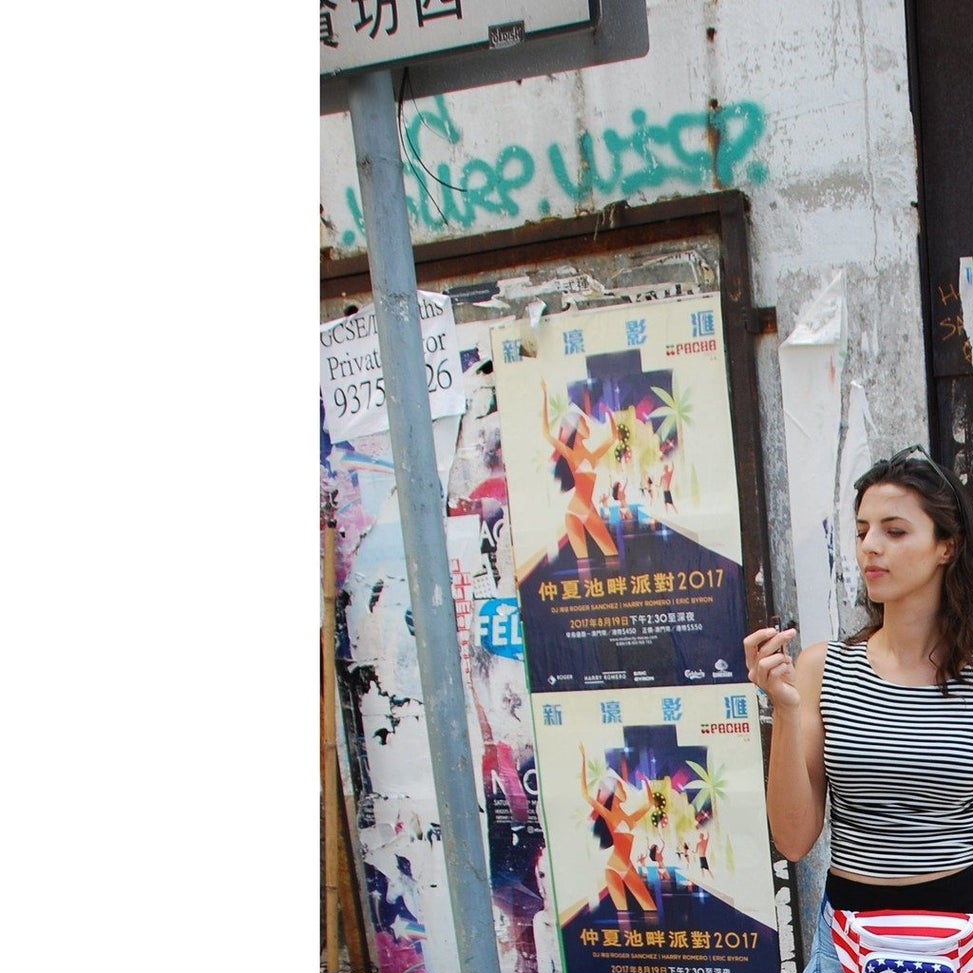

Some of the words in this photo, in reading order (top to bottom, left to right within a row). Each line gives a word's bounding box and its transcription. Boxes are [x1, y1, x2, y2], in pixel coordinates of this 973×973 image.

[675, 339, 717, 356] PACHA
[327, 349, 381, 381] Privat
[538, 568, 724, 602] 仲夏池畔派對2017
[542, 695, 748, 726] 新濠影匯
[711, 722, 750, 735] PACHA
[580, 928, 759, 950] 仲夏池畔派對2017
